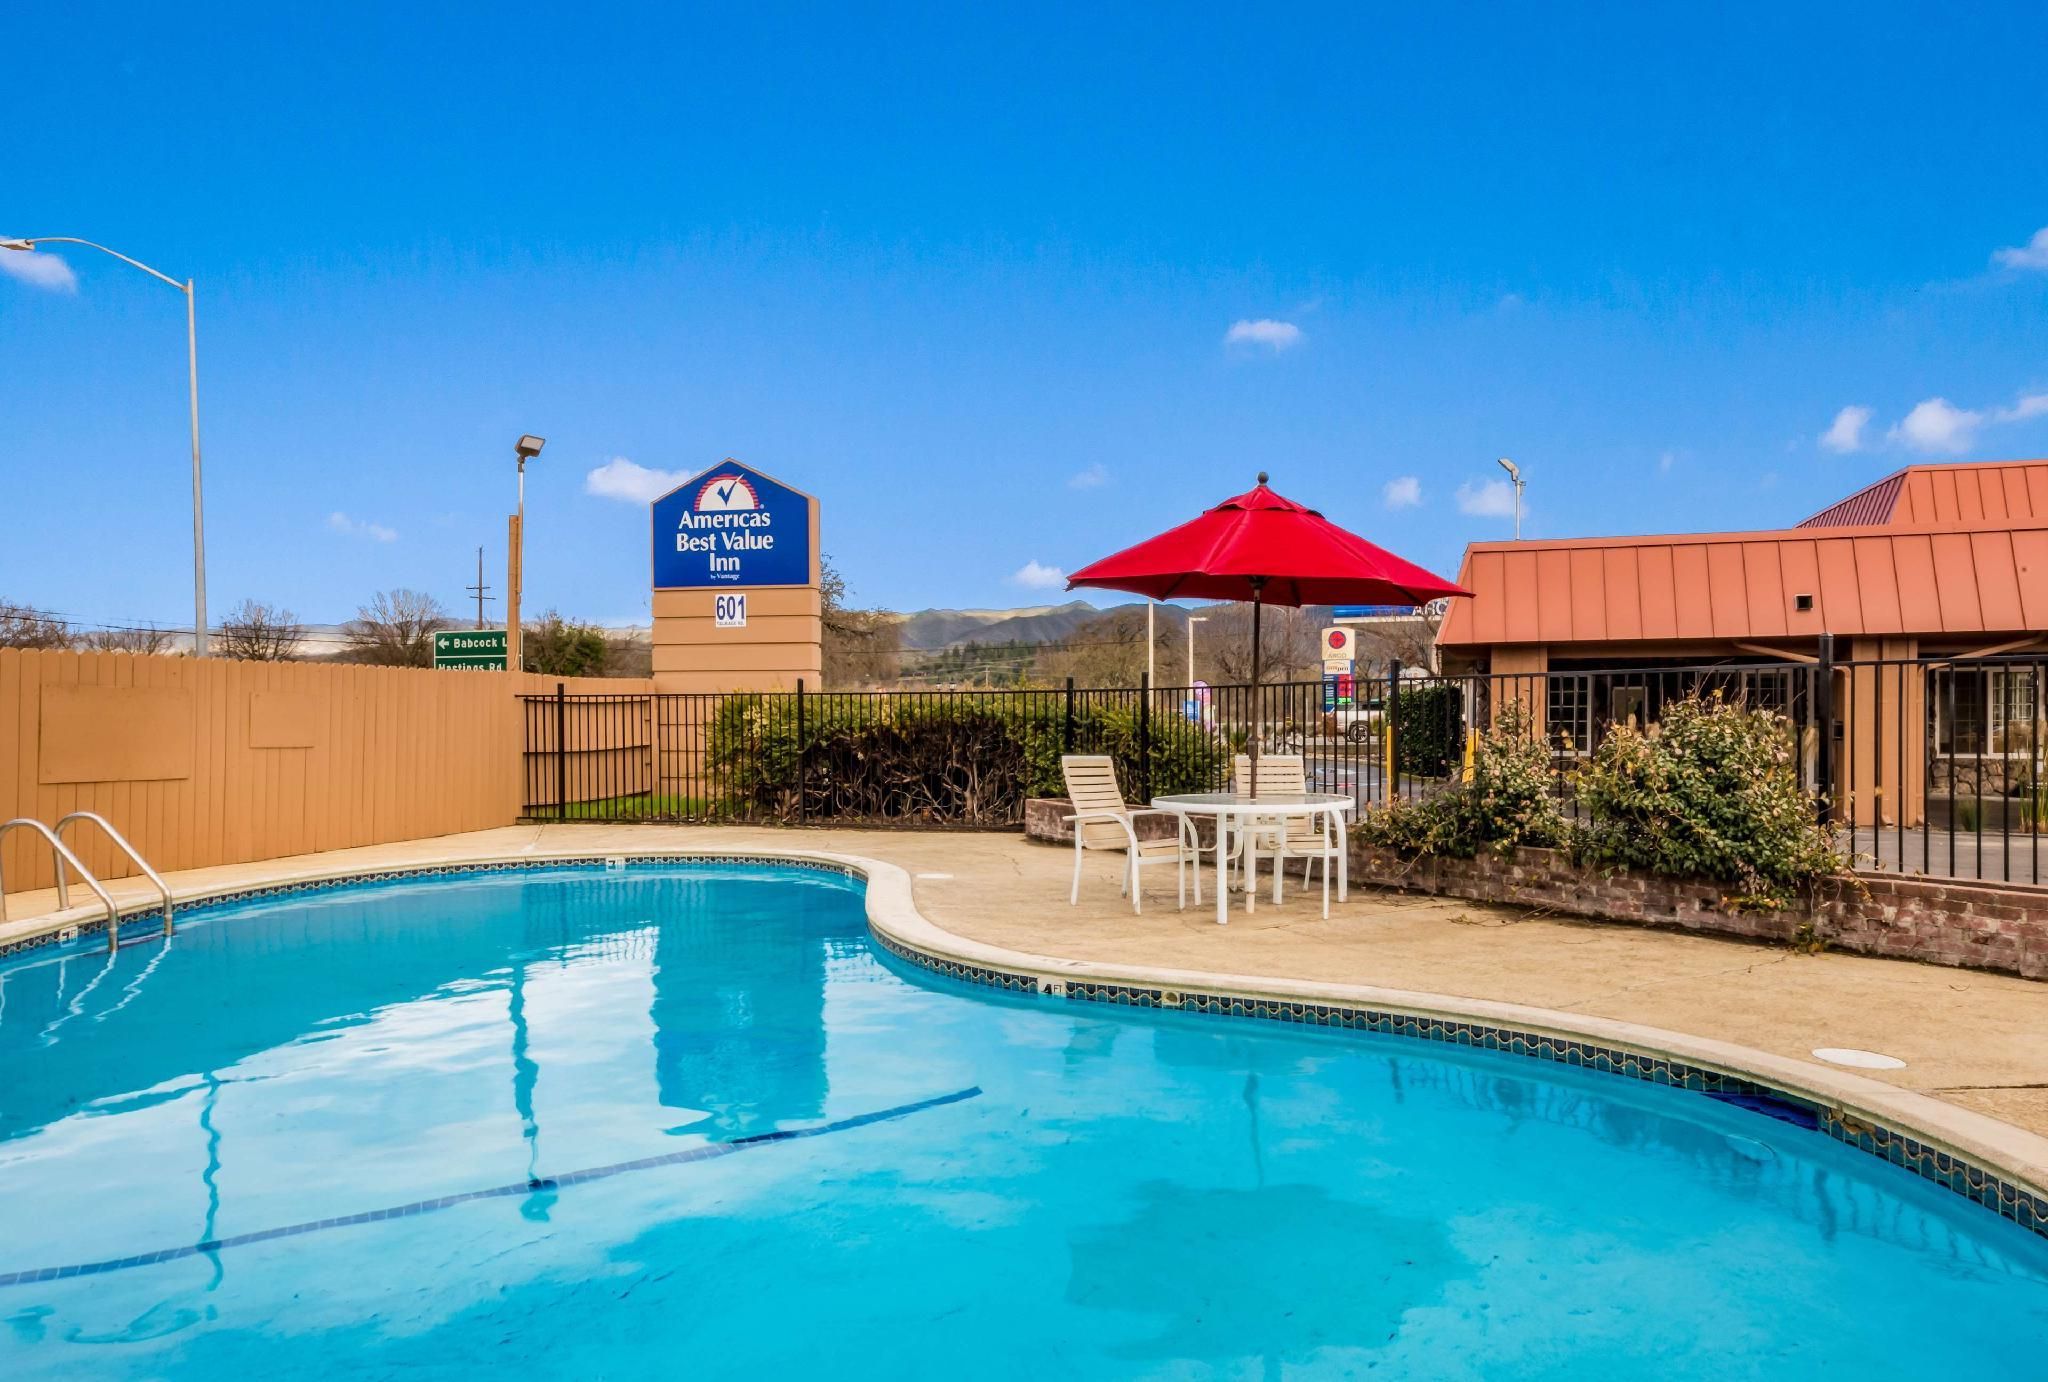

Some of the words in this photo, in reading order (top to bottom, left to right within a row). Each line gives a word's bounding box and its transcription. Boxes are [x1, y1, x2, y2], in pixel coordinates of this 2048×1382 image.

[678, 510, 770, 529] Americas
[676, 533, 716, 552] Best
[721, 529, 774, 551] Value
[709, 553, 740, 572] Inn
[717, 572, 740, 581] Vantage
[716, 595, 745, 621] 601
[453, 638, 498, 649] Babcock
[438, 662, 484, 672] Hastings
[489, 662, 502, 672] Rd
